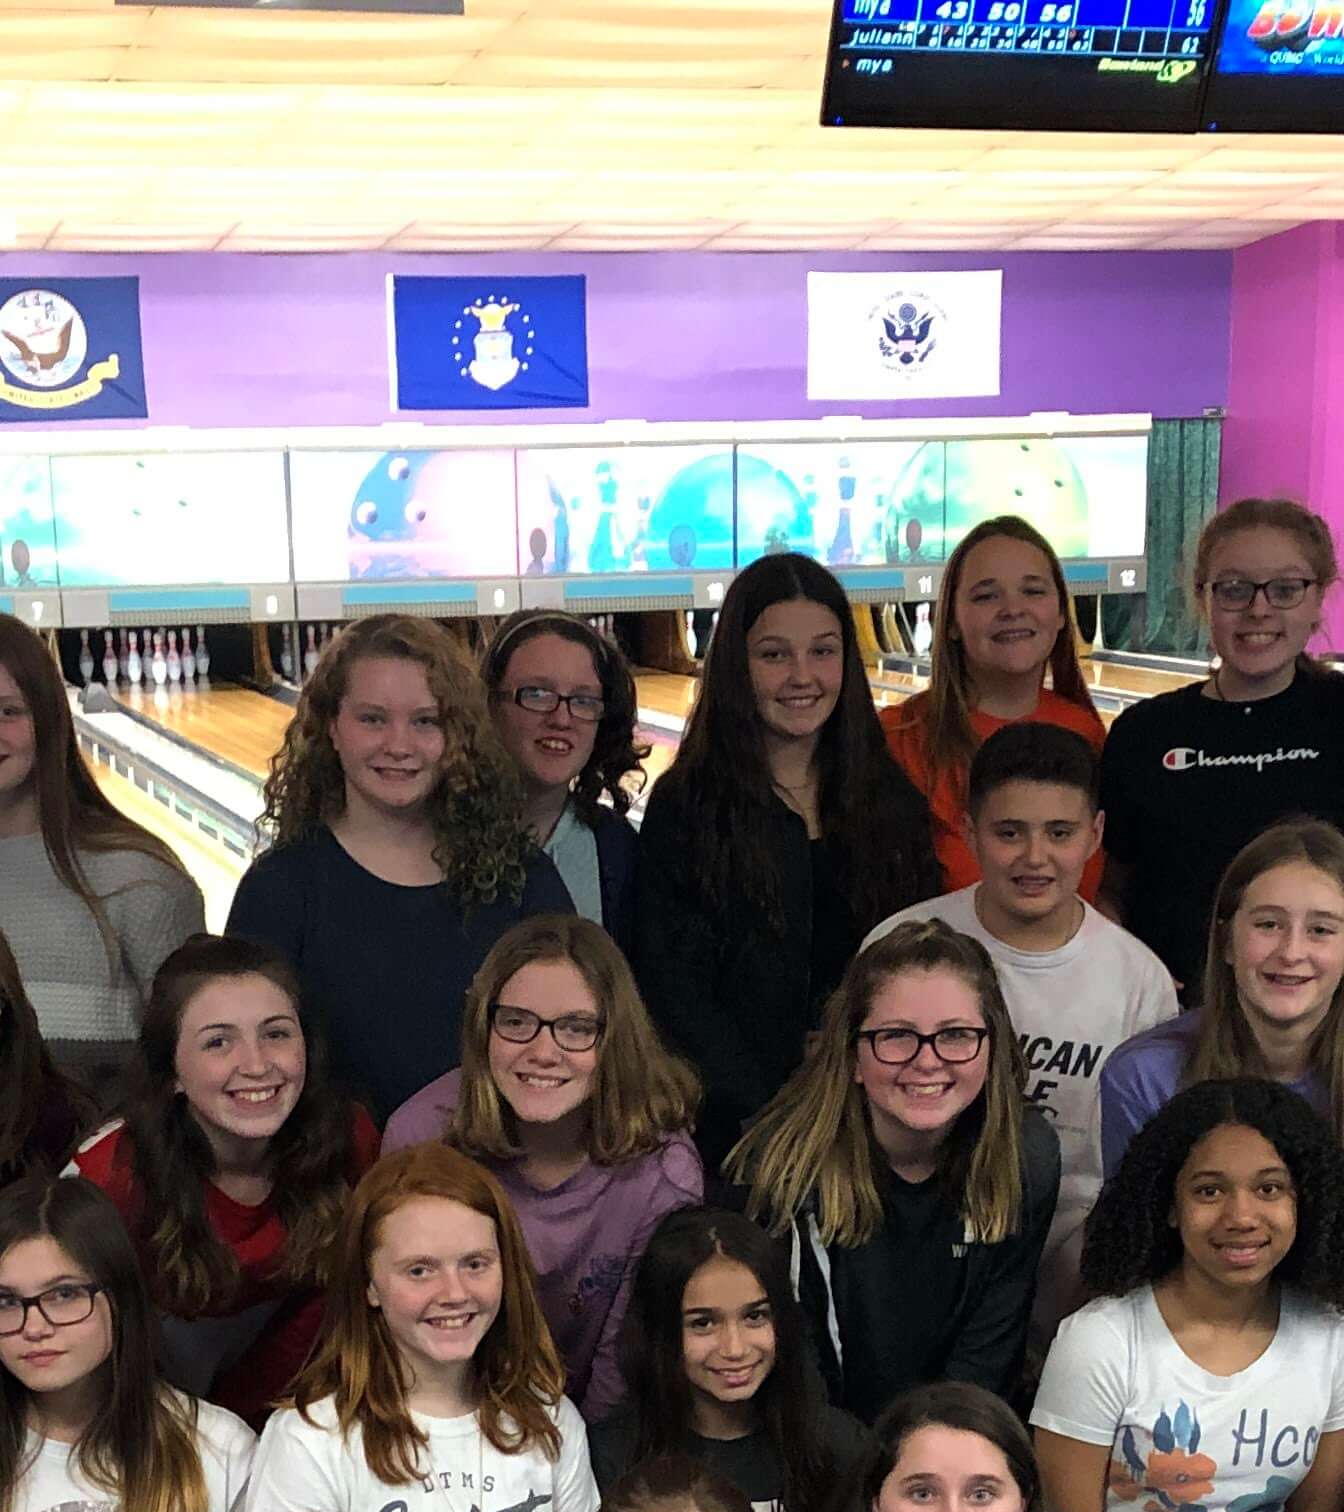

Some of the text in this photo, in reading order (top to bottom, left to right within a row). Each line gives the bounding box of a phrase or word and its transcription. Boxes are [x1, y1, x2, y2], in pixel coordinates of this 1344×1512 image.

[936, 1, 969, 19] 43
[987, 3, 1021, 21] 50
[1040, 4, 1073, 22] 56
[856, 58, 893, 74] mya
[1119, 569, 1136, 587] 12
[1163, 747, 1320, 773] Champion
